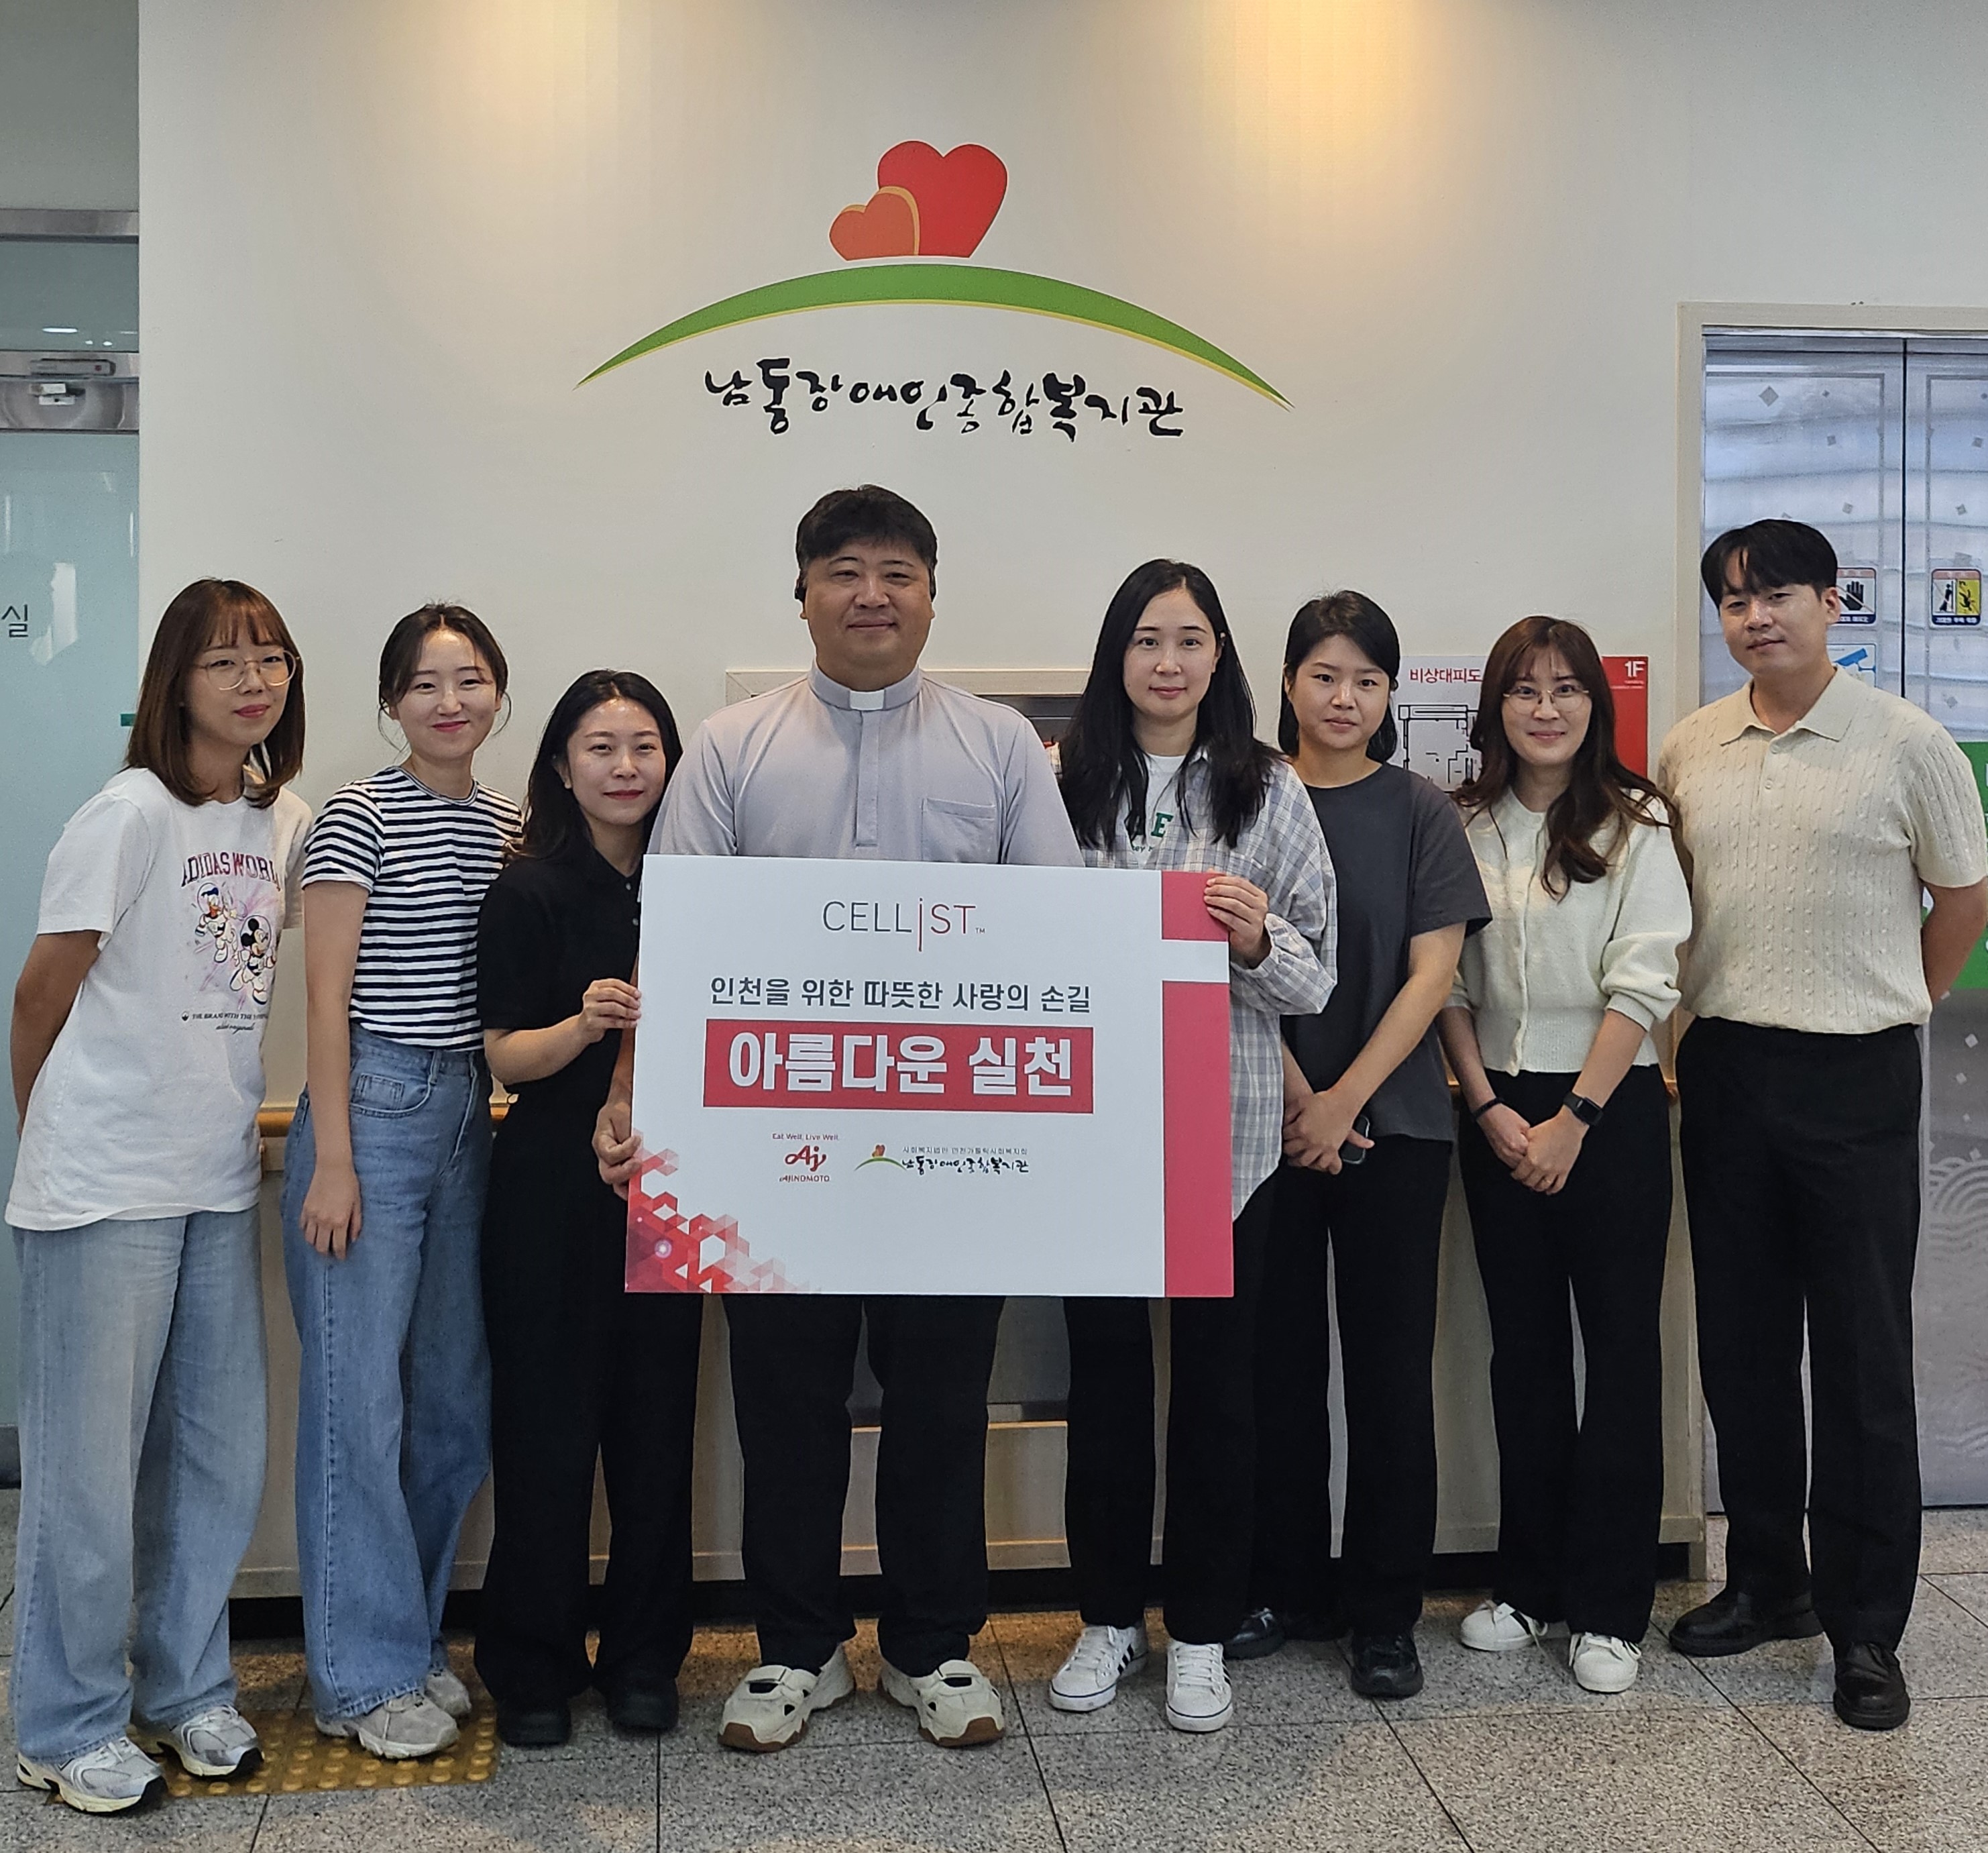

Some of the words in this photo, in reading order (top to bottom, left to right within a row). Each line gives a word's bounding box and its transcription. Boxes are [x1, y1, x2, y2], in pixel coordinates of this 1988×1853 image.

[705, 356, 1184, 443] 남동장애인종합복지관
[1410, 668, 1483, 684] 비상대피도
[1624, 661, 1646, 677] 1F
[710, 976, 790, 1006] 인천을
[801, 978, 854, 1008] 위한
[864, 980, 944, 1010] 따뜻한
[952, 982, 1029, 1012] 사랑의
[1041, 985, 1091, 1014] 손길
[729, 1032, 947, 1094] 아름다운
[969, 1037, 1071, 1097] 실천
